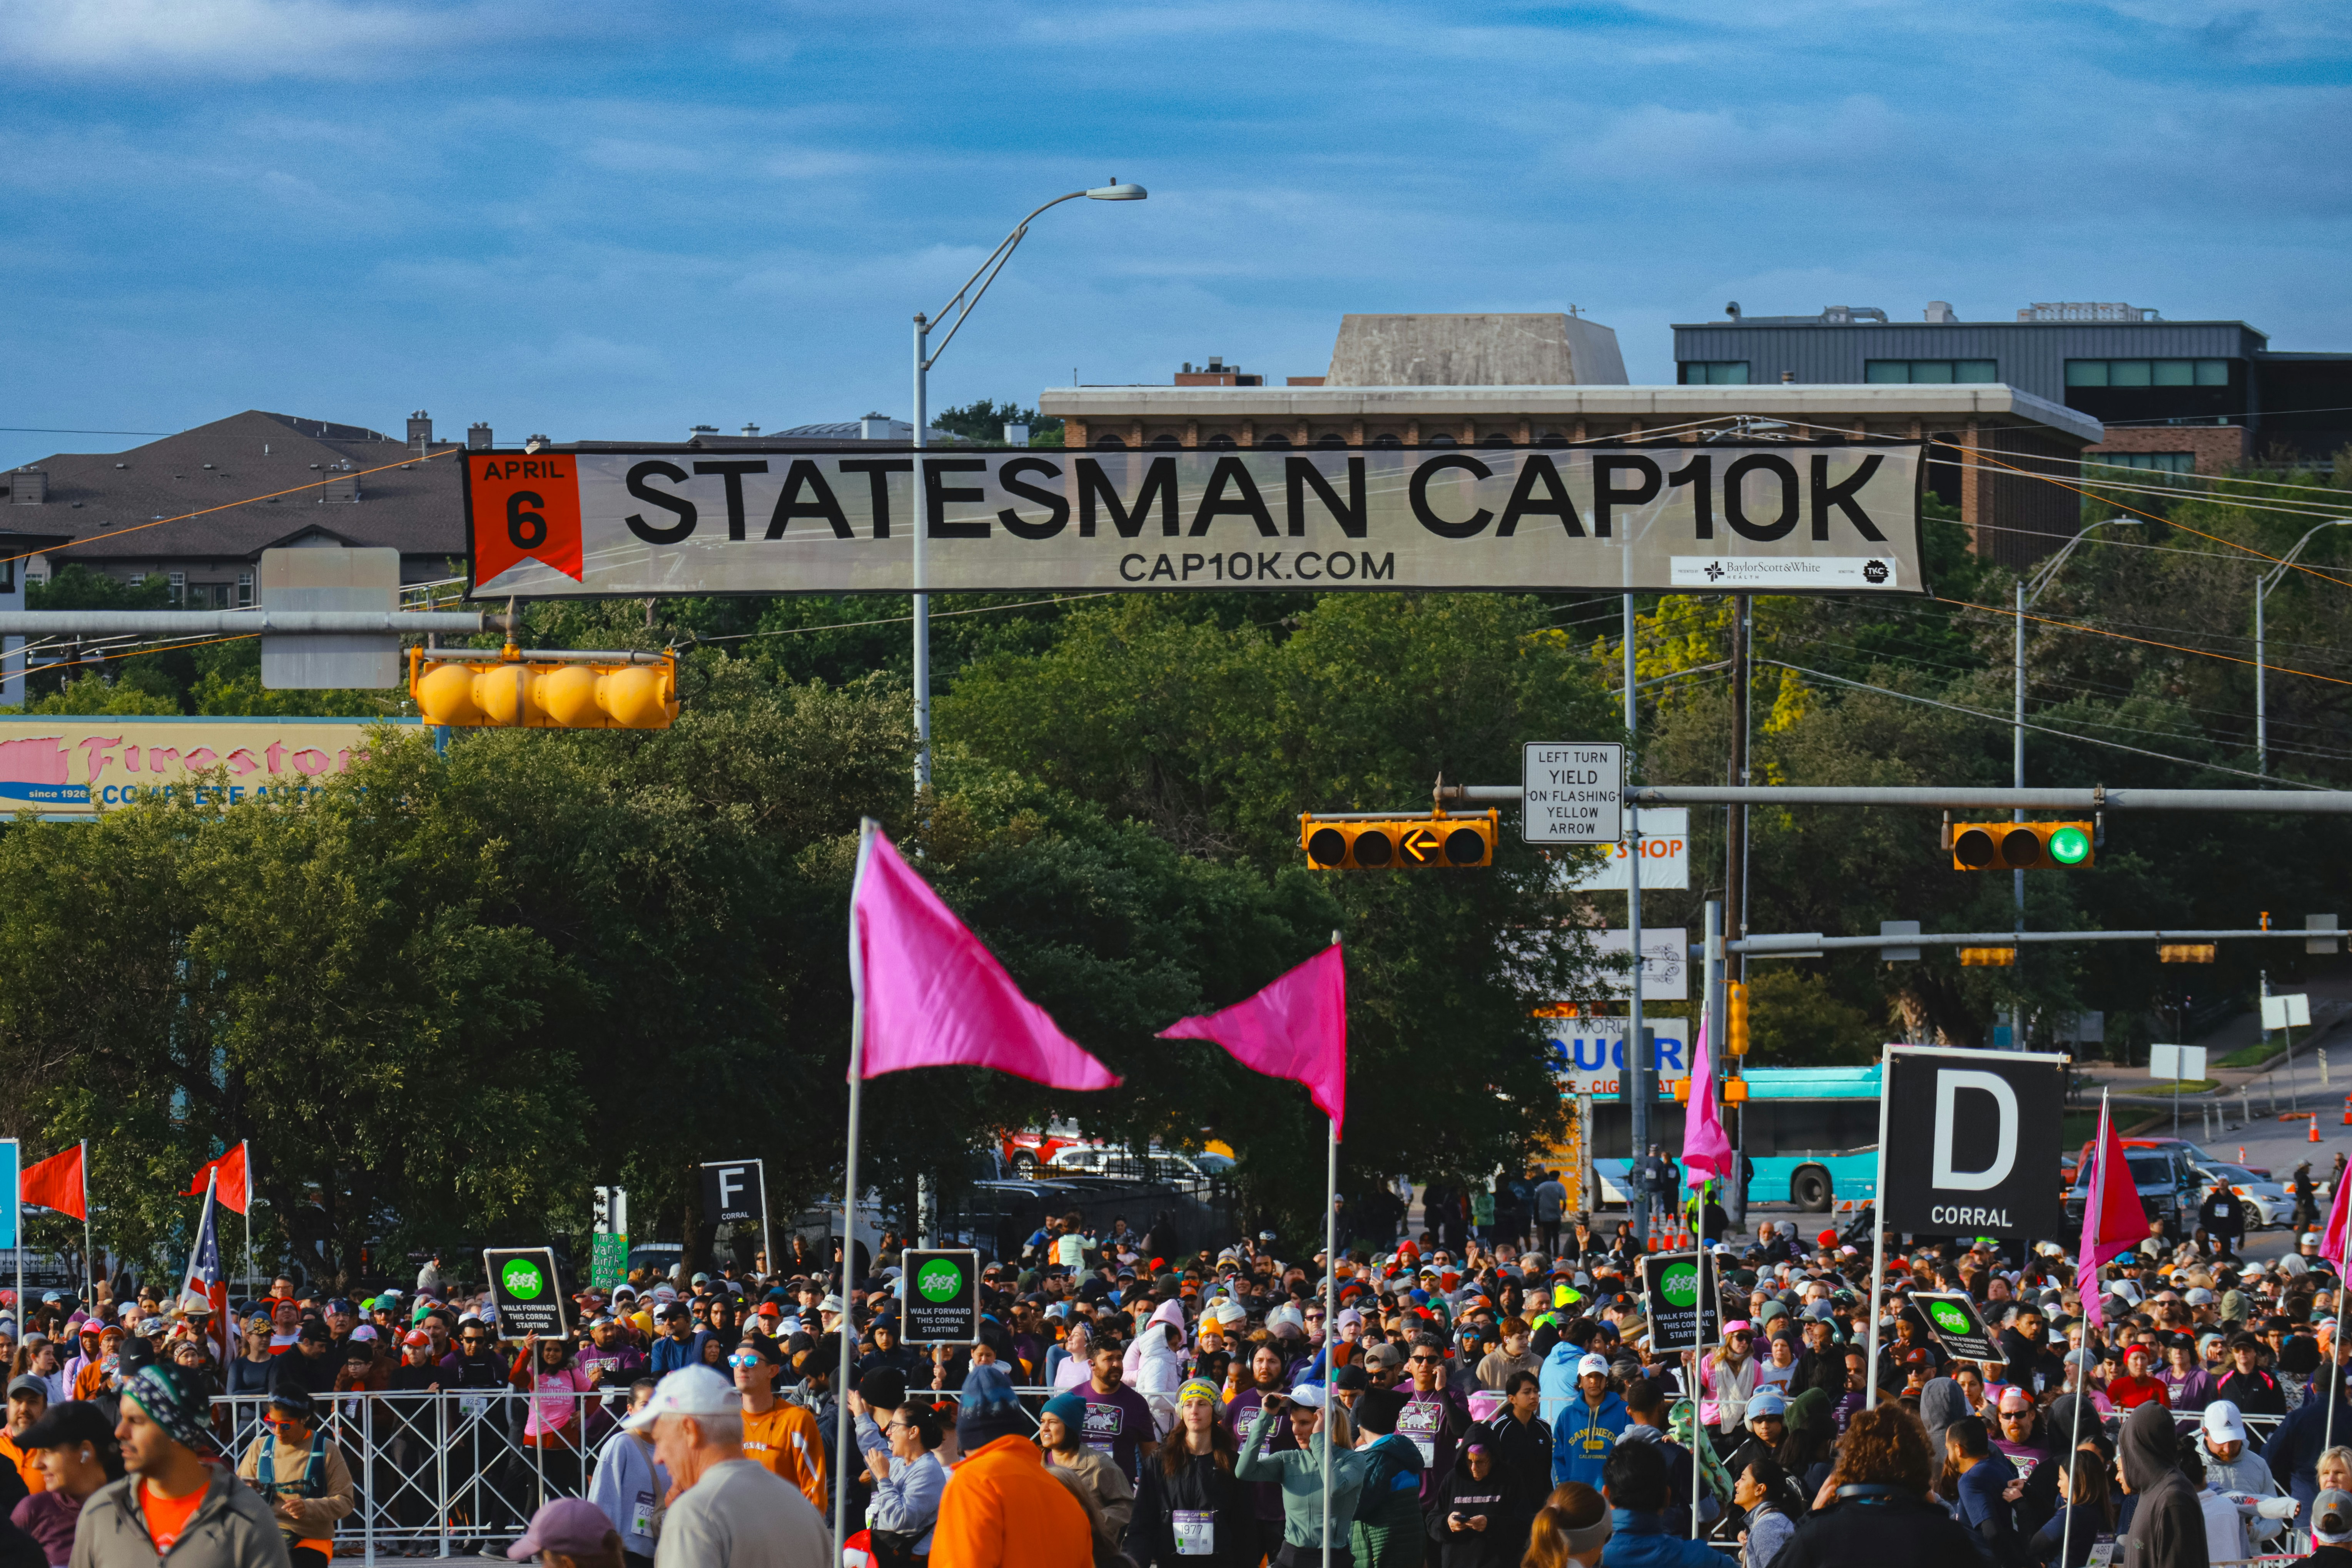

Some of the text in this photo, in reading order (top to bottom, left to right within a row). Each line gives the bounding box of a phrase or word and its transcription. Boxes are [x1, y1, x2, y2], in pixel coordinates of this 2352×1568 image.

[484, 459, 565, 481] APRIL
[624, 453, 1888, 544] STATESMAN CAP10K
[505, 491, 547, 549] 6
[1119, 551, 1394, 581] CAP10K.COM
[1727, 561, 1820, 574] BaylorScott&White
[78, 735, 372, 783] Firesto
[1539, 752, 1607, 763] LEFT TURN
[1549, 770, 1597, 784] YIELD
[29, 790, 57, 798] since
[1530, 791, 1615, 802] ON FLASHING
[1547, 807, 1598, 818] YELLOW
[1549, 823, 1595, 834] ARROW
[1574, 1020, 1630, 1034] WORL
[1932, 1069, 2018, 1191] D
[719, 1167, 744, 1209] F
[722, 1212, 749, 1220] CORRAL
[1932, 1206, 2013, 1227] CORRAL
[593, 1244, 622, 1255] Van's
[596, 1266, 614, 1277] day
[595, 1276, 621, 1287] team
[1681, 1320, 1710, 1328] CORAL
[1670, 1330, 1706, 1339] STARTIG
[539, 1388, 570, 1400] OLUNTEER
[1569, 1428, 1589, 1446] SAN
[743, 1441, 767, 1451] EXAS
[1181, 1525, 1203, 1535] 1977
[2096, 1546, 2110, 1555] 4963
